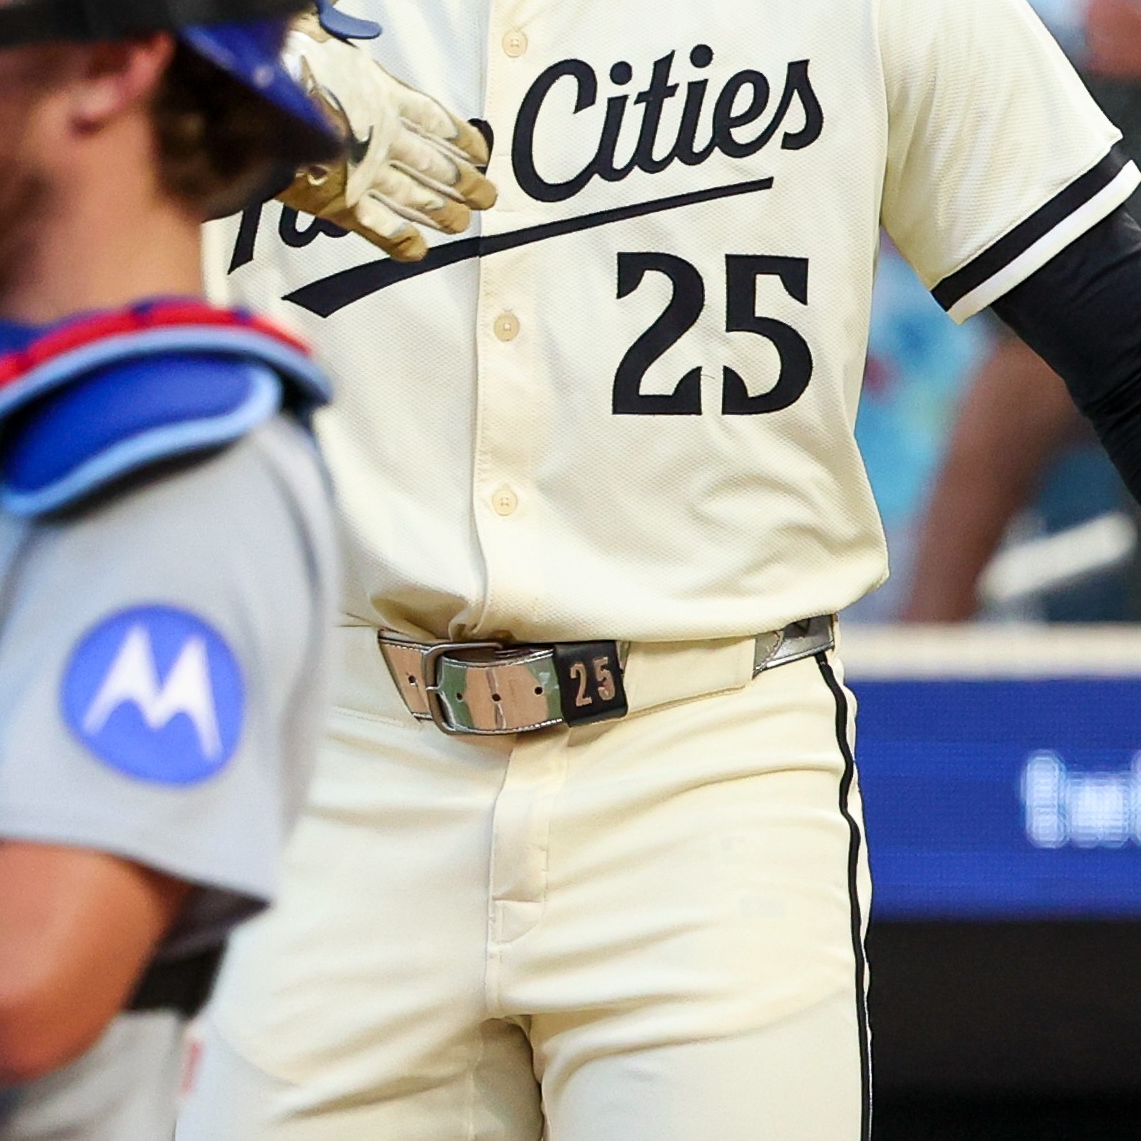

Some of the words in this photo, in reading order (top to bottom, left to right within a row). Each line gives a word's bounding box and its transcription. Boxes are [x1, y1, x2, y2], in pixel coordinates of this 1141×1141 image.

[511, 44, 825, 204] Cities
[611, 251, 814, 417] 25
[569, 656, 617, 708] 25
